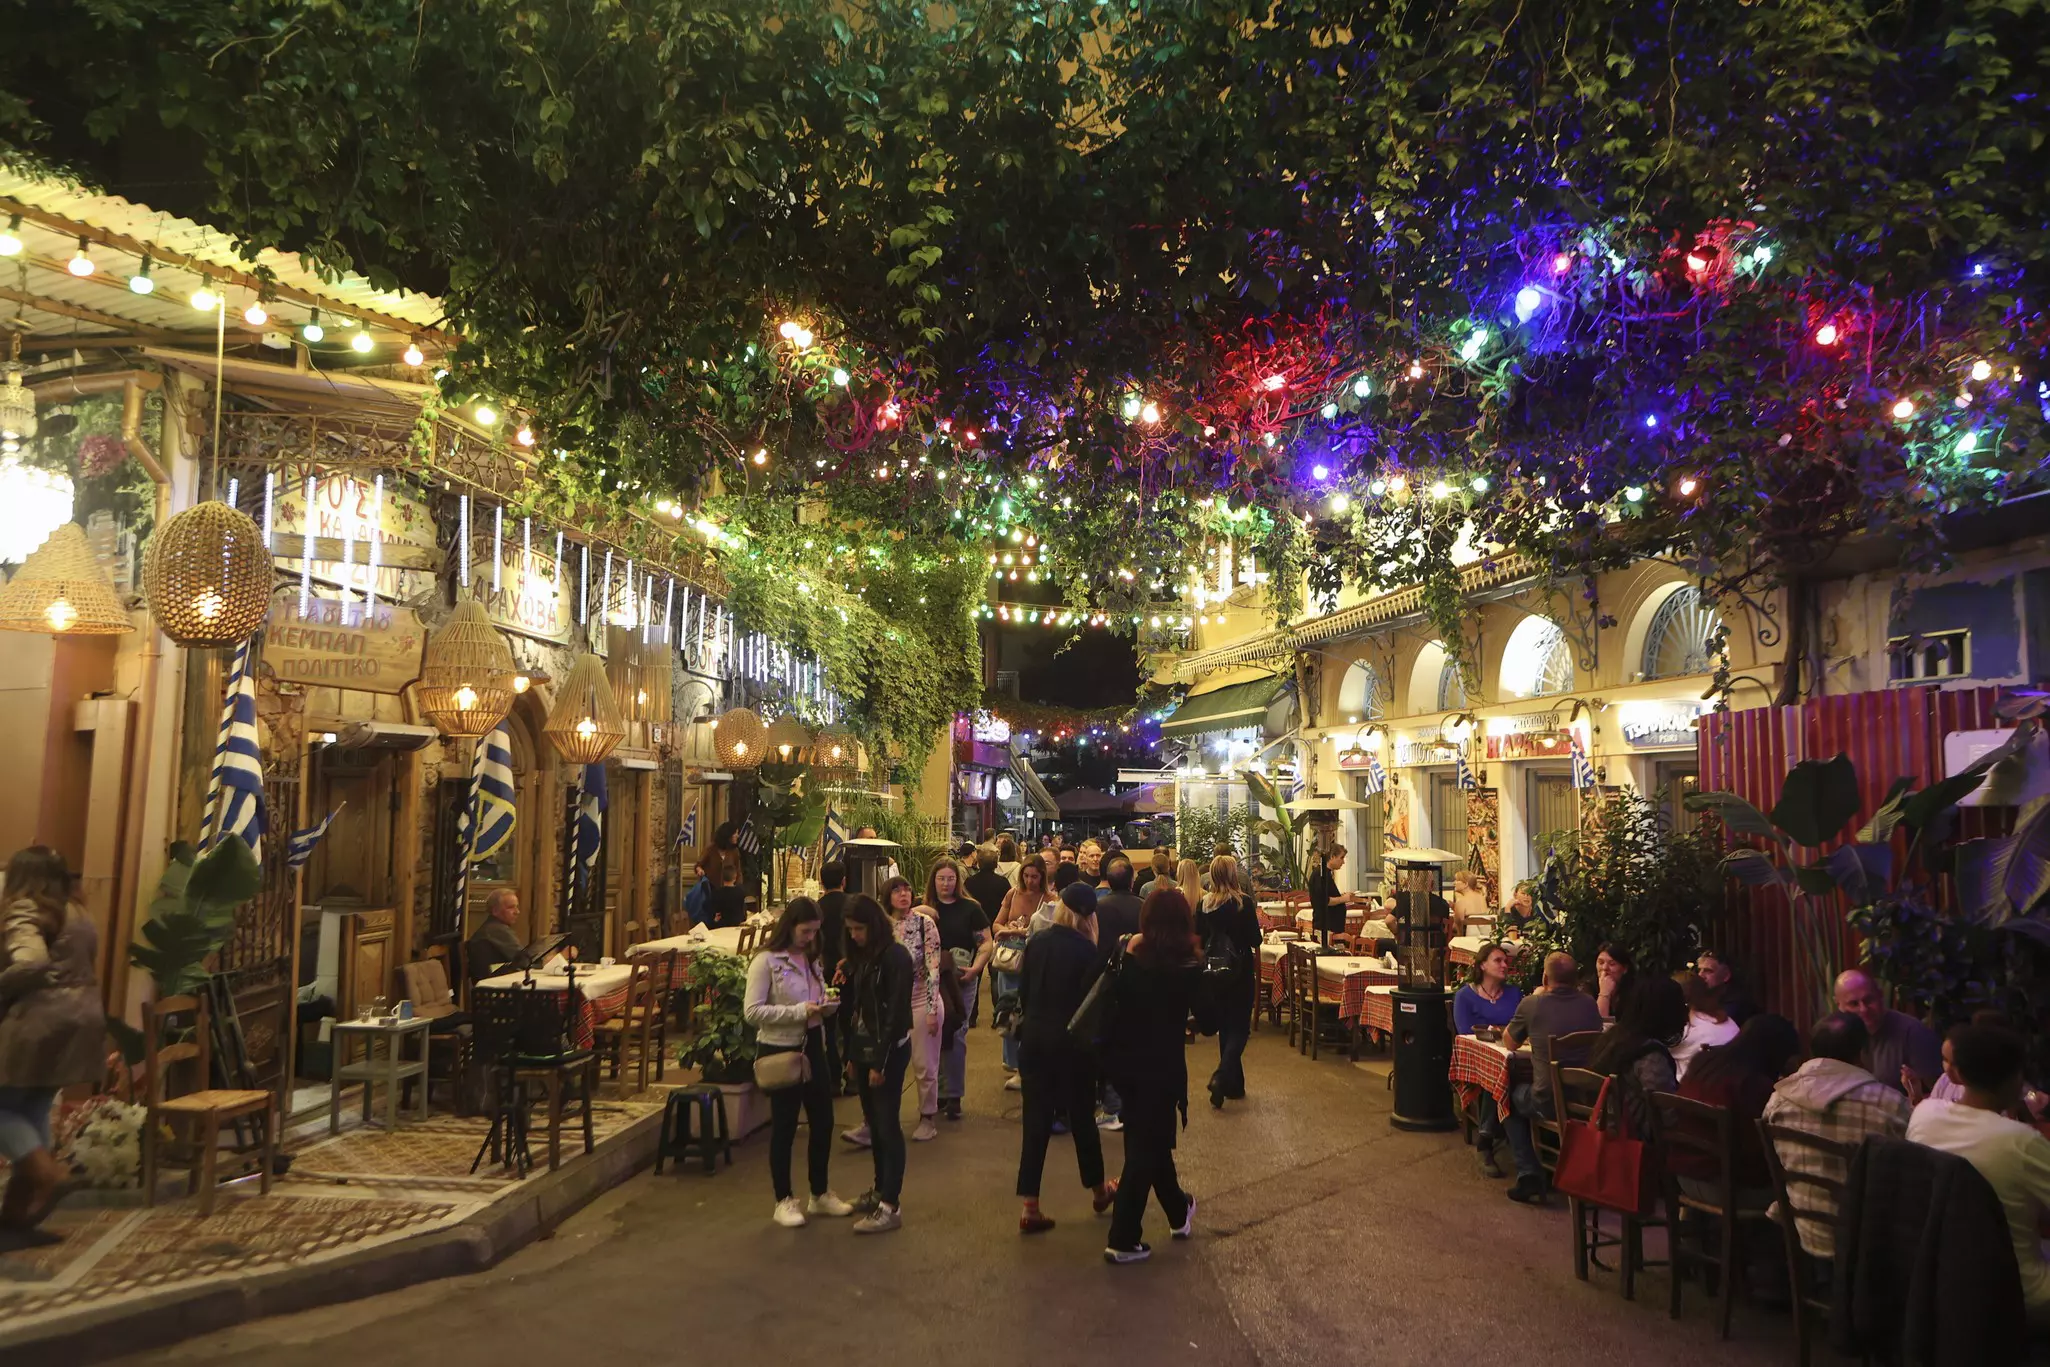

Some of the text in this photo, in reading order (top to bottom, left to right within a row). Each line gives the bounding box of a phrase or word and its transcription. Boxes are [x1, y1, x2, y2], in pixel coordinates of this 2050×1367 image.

[472, 575, 558, 631] ΑΡΑΧΩΒΑ
[269, 625, 366, 656] ΚΕΜΠΑΠ
[282, 657, 379, 677] ΠΟΛΙΤΙΚΟ
[1503, 728, 1585, 758] ΑΡΑΒΑ
